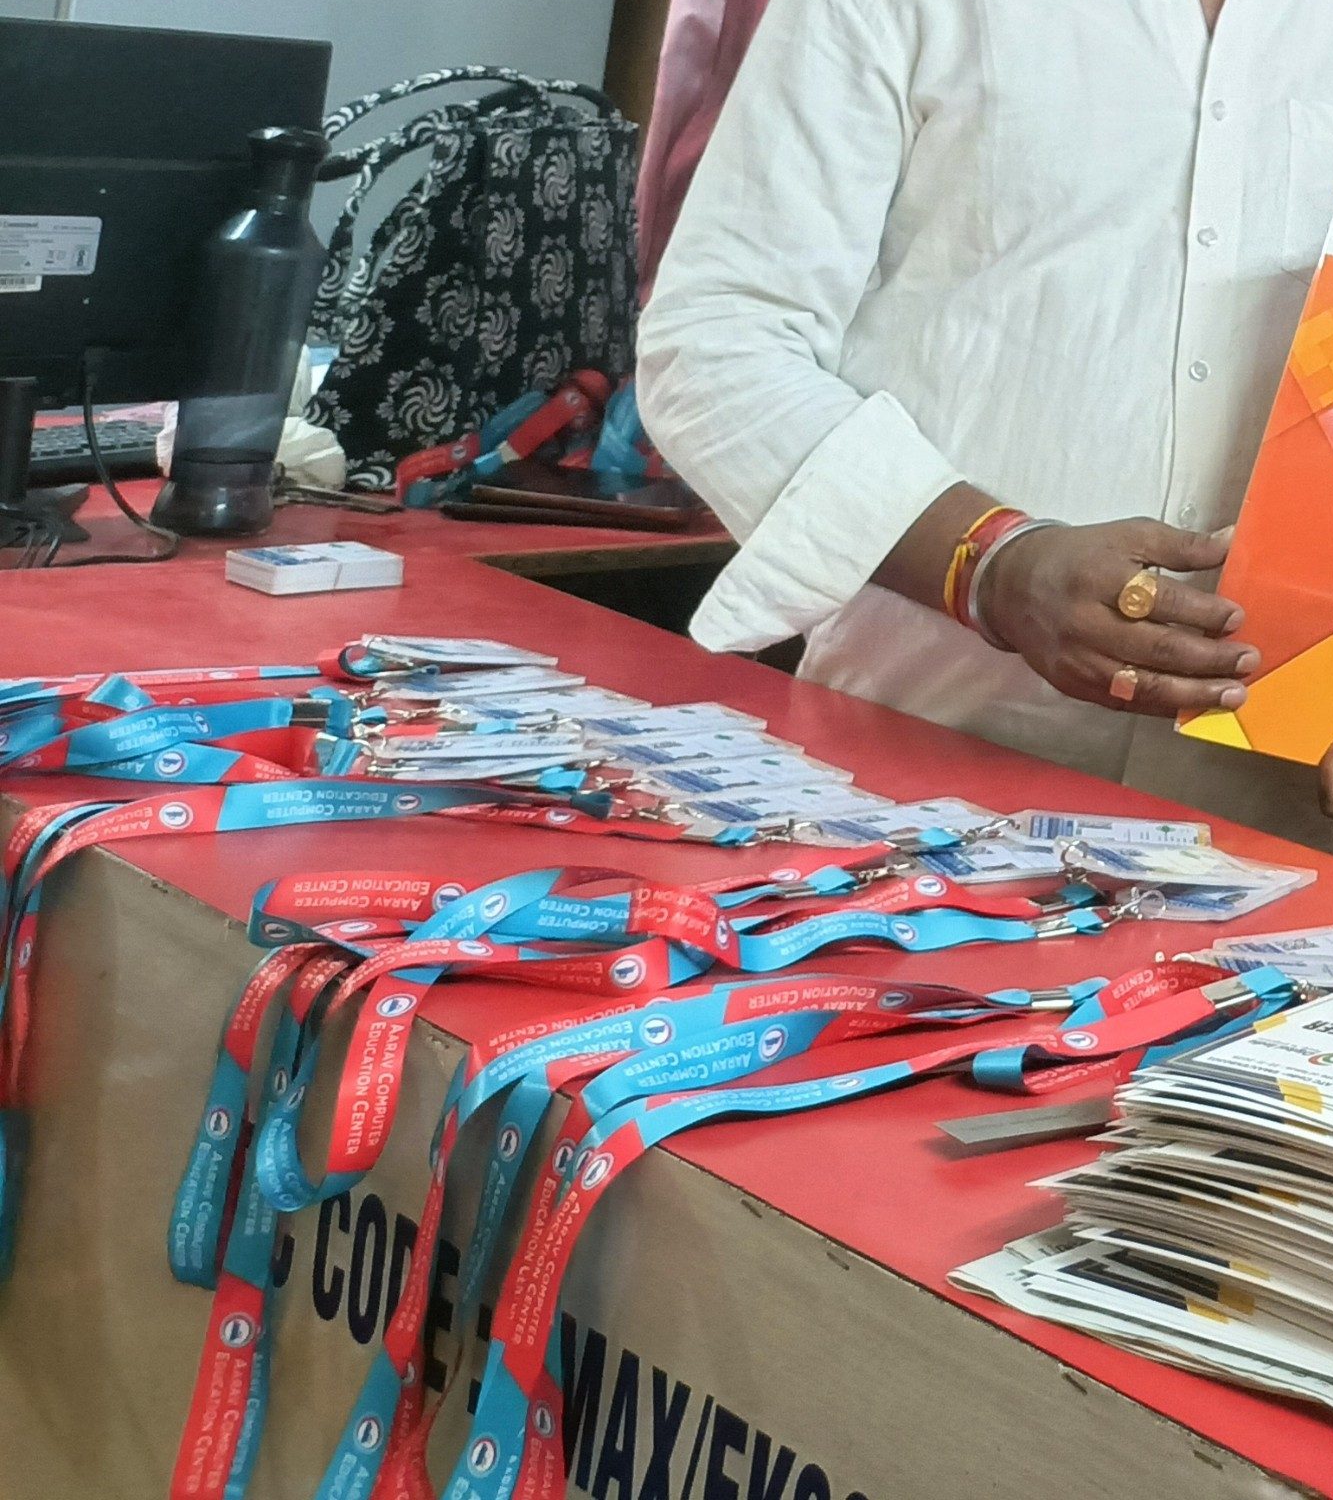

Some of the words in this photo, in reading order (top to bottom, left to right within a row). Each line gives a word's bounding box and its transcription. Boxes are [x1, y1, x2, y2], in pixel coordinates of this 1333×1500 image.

[263, 789, 313, 803] CENTER
[267, 803, 335, 819] COMPUTER
[294, 880, 349, 894] CENTER
[352, 880, 431, 895] EDUCATION
[295, 895, 370, 909] COMPUTER
[372, 895, 423, 911] AARAV
[539, 900, 591, 916] CENTER
[538, 915, 609, 933] COMPUTER
[802, 986, 877, 999] EDUCATION
[1111, 969, 1155, 999] CENTER
[1122, 977, 1180, 1012] COMPUTER
[748, 990, 800, 1009] CENTER
[548, 1021, 634, 1048] EDUCATION
[679, 1031, 756, 1059] EDUCATION
[357, 1021, 387, 1097] EDUCATION
[380, 1023, 406, 1071] AARAV
[581, 1037, 633, 1057] AARAV
[623, 1052, 678, 1077] CENTER
[711, 1051, 752, 1074] AARAV
[639, 1063, 709, 1088] COMPUTER
[368, 1072, 396, 1147] COMPUTER
[345, 1099, 370, 1156] CENTER
[513, 1282, 537, 1345] CENTER
[526, 1261, 556, 1346] COMPUTER
